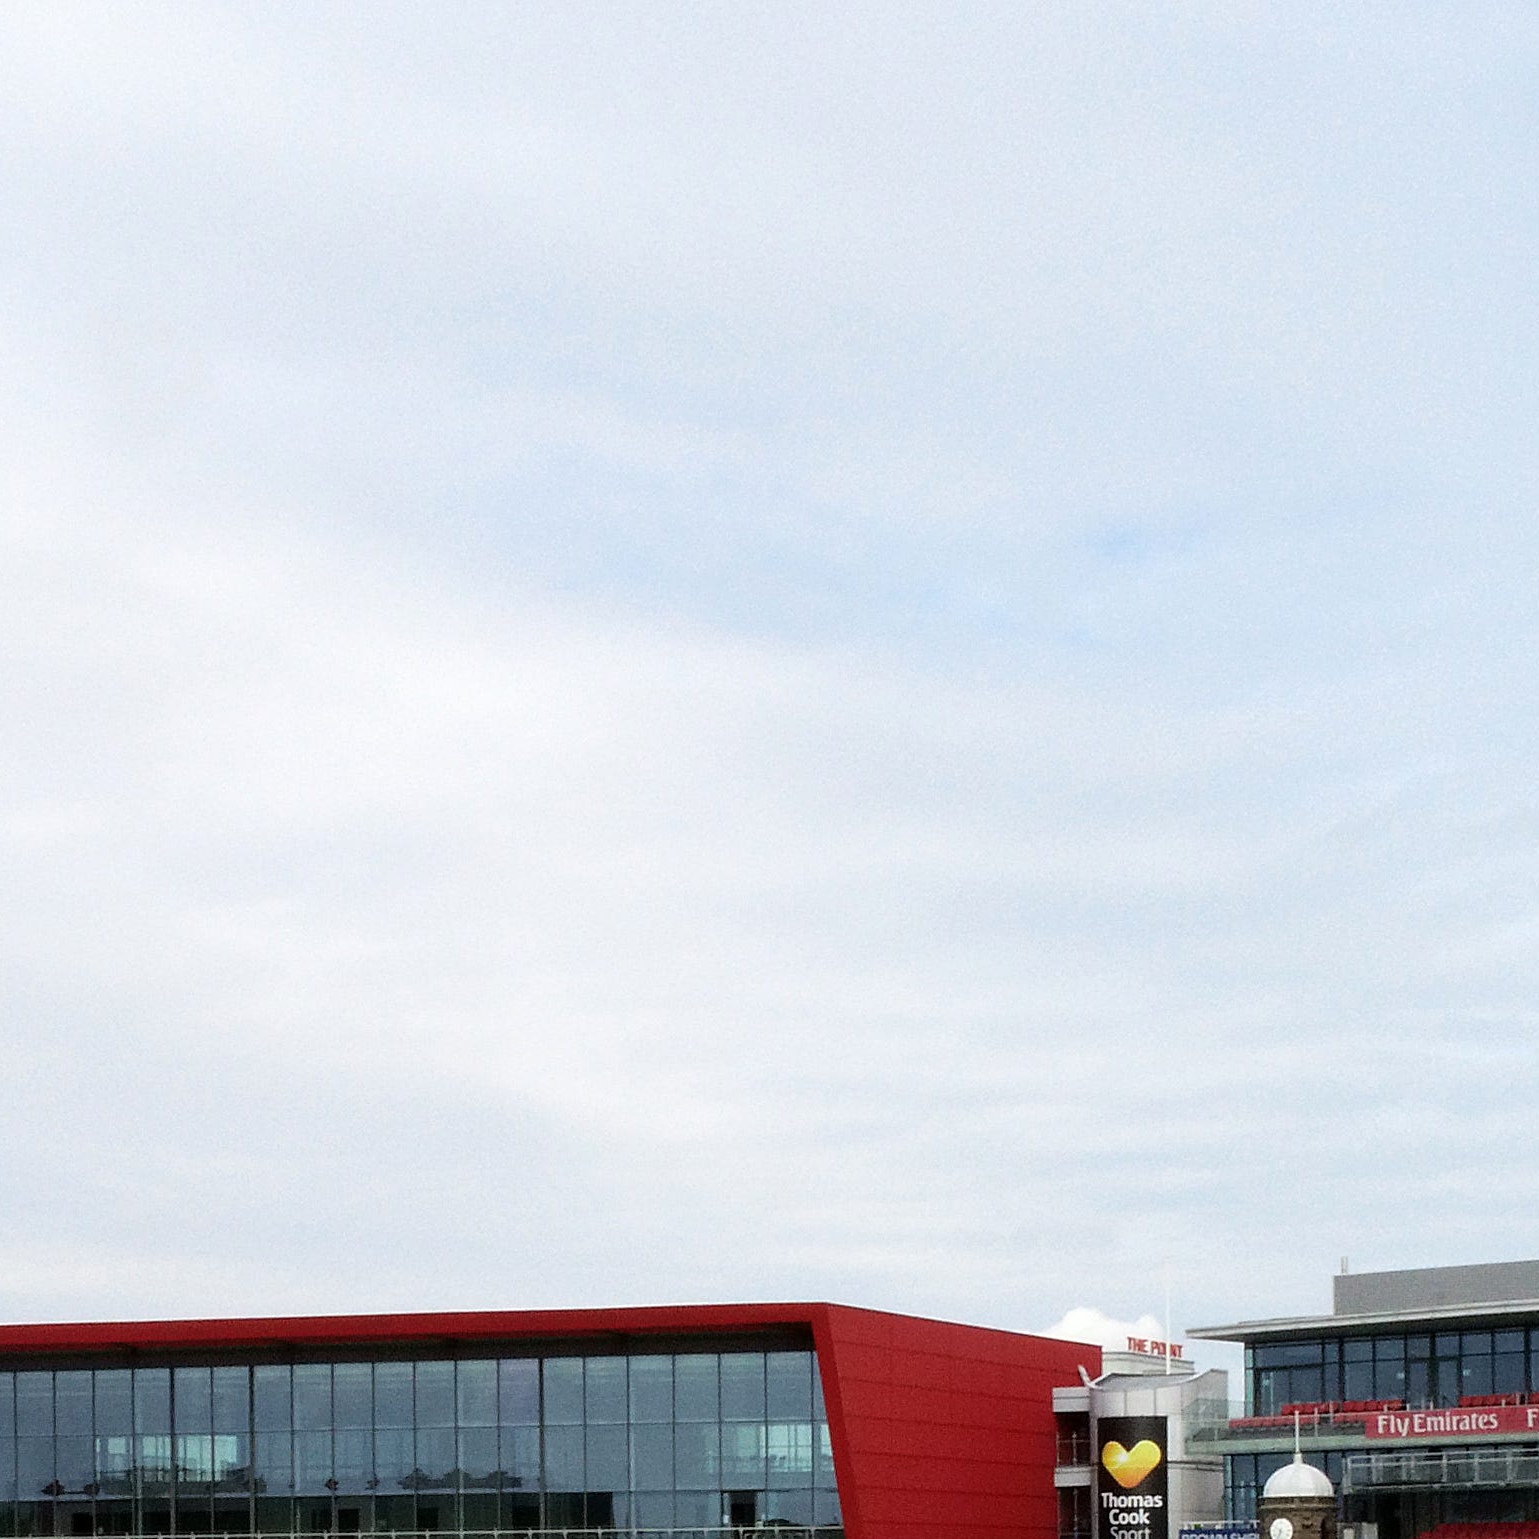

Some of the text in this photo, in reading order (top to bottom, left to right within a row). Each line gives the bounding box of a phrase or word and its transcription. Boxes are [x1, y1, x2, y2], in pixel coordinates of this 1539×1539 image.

[1127, 1336, 1148, 1353] THE
[1377, 1411, 1498, 1436] Fly Emirates
[1102, 1492, 1162, 1508] Thomas
[1109, 1509, 1150, 1525] Cook
